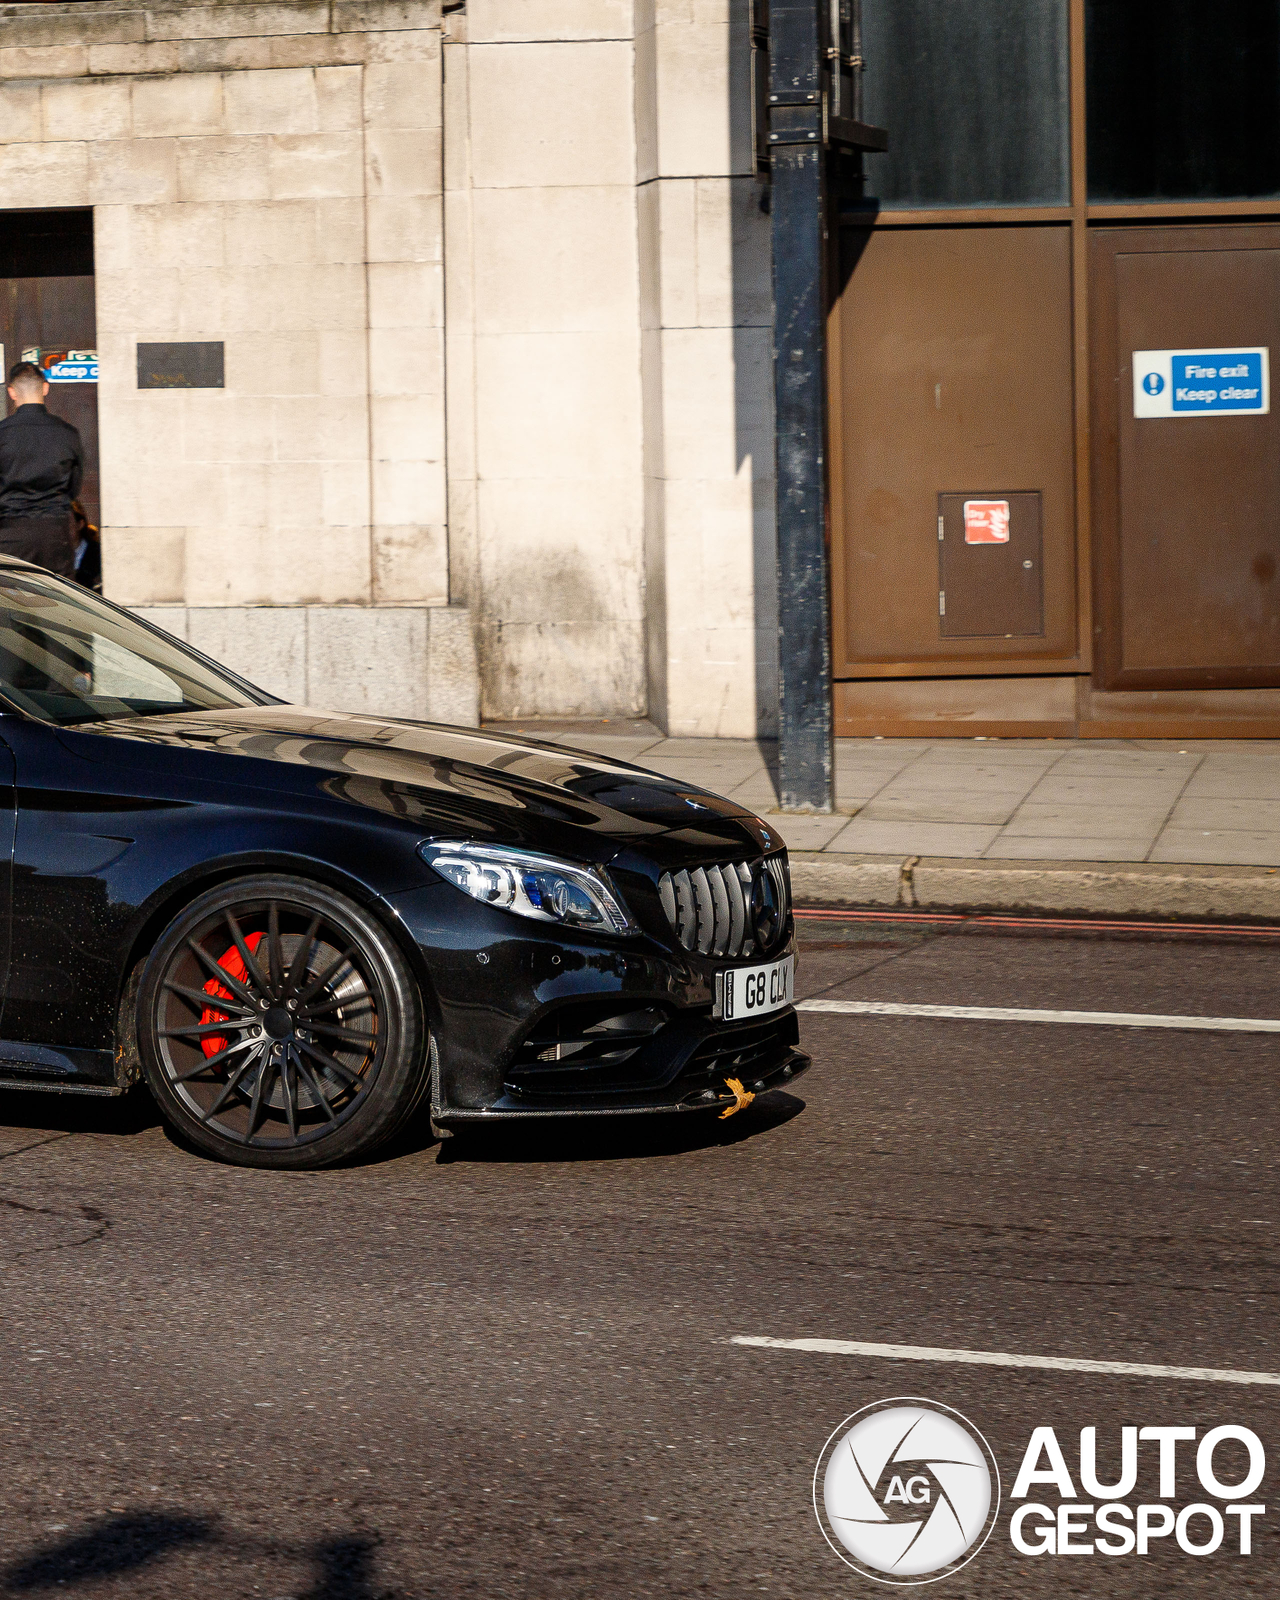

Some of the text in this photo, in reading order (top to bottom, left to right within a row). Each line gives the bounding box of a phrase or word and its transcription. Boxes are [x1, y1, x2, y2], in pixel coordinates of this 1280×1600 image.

[51, 366, 88, 378] Keep
[1184, 364, 1250, 379] Fire exit
[1176, 386, 1259, 403] Keep clear
[745, 965, 788, 1009] G8 CLX
